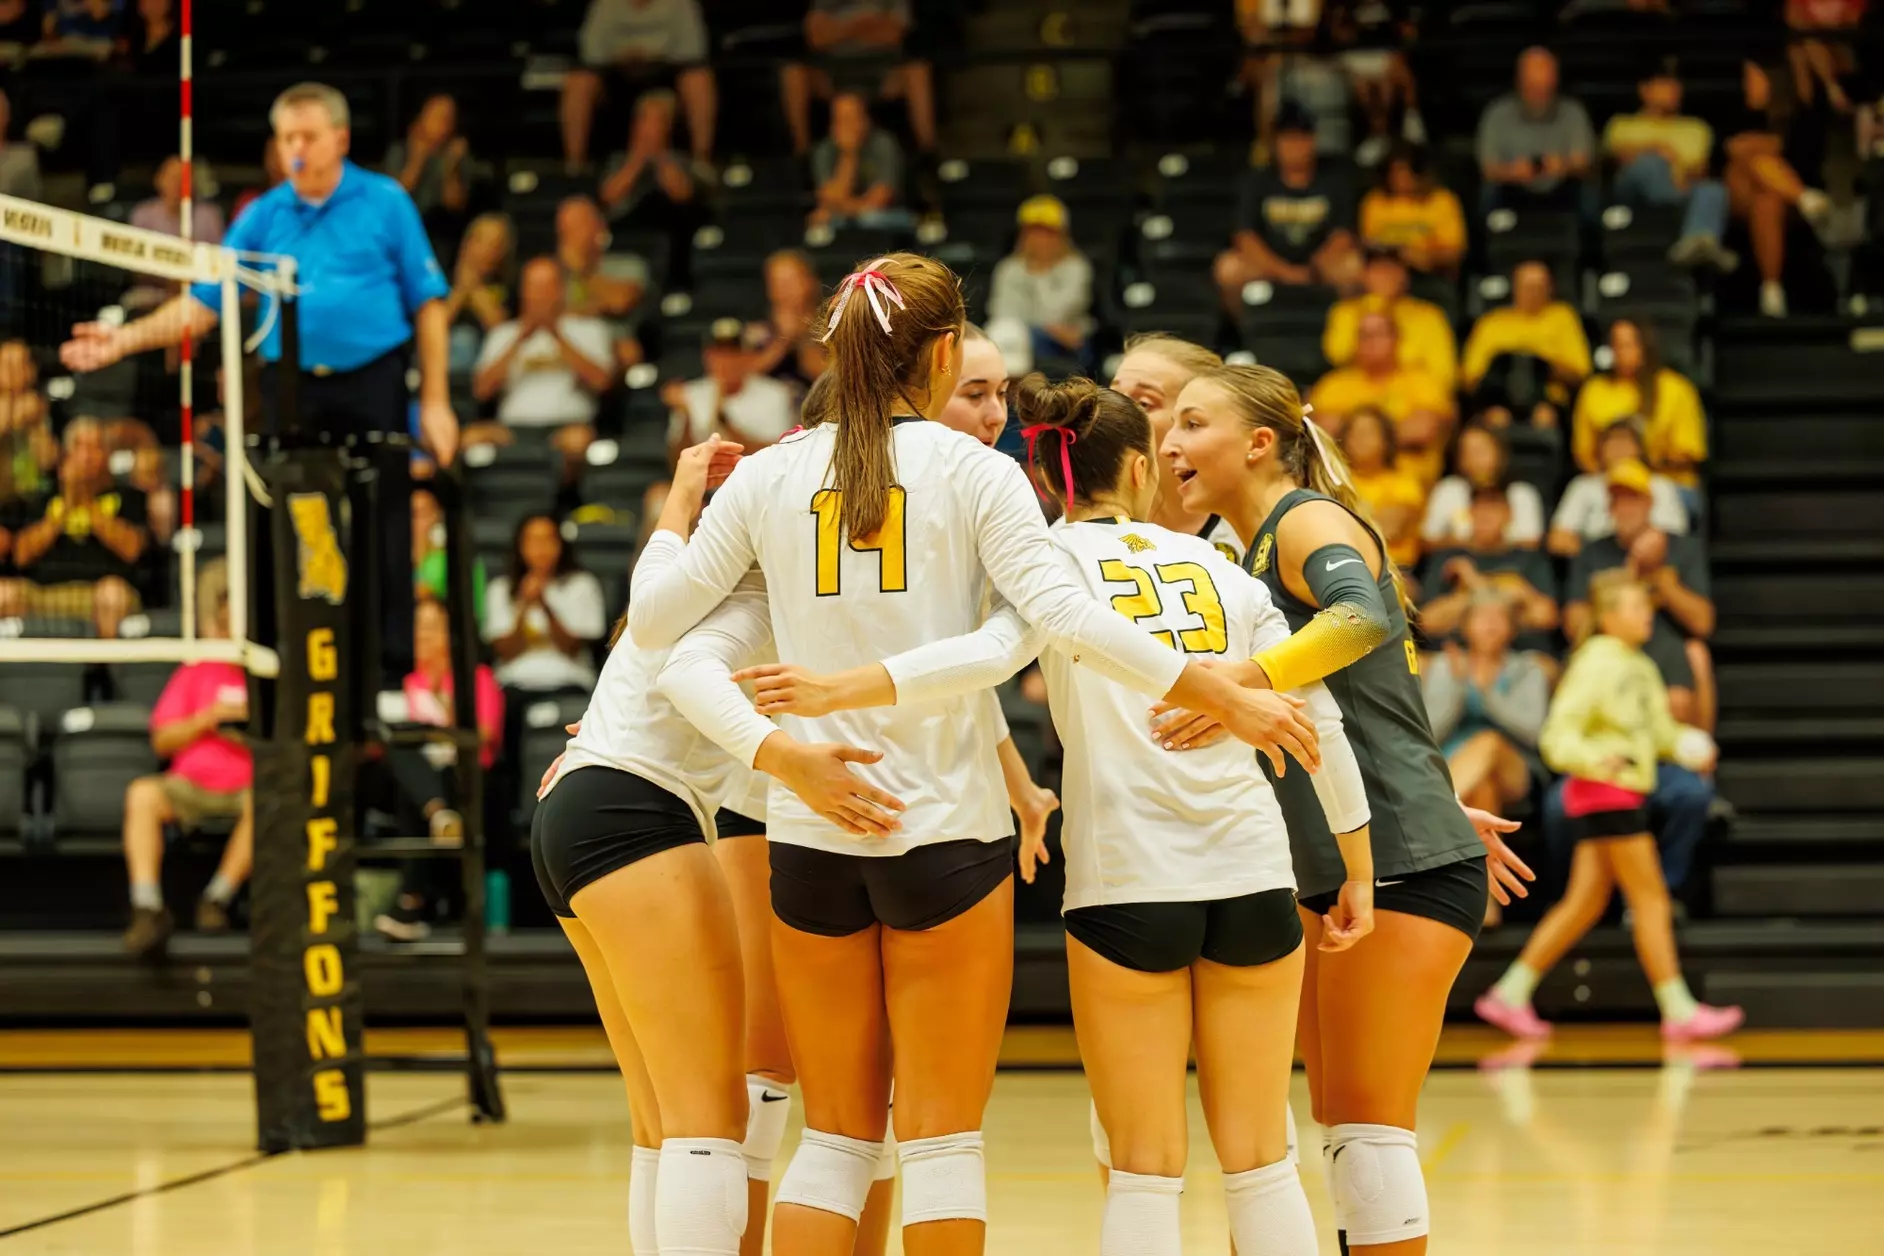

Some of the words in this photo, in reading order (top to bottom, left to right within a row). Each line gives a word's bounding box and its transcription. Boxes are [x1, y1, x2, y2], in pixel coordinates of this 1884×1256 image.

[810, 485, 907, 597] 14
[1098, 558, 1228, 654] 23
[305, 628, 351, 1122] GRIFFONS
